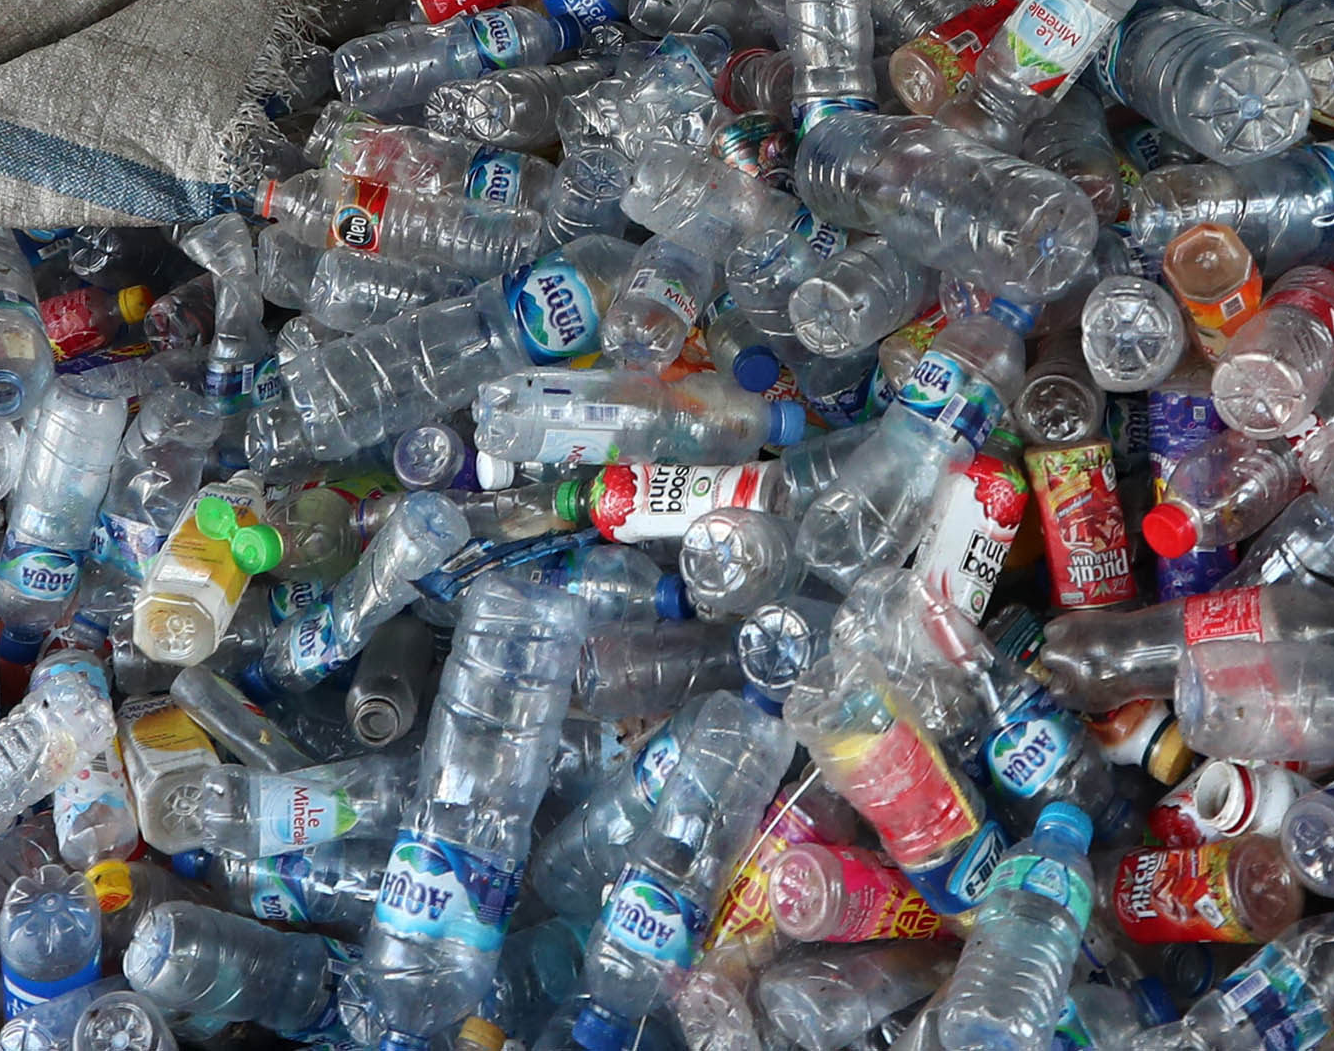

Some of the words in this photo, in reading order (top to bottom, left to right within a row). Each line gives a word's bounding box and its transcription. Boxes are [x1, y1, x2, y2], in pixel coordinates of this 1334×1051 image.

[486, 15, 507, 53] AQUA
[1027, 0, 1083, 49] Minerale
[1035, 26, 1055, 46] Le
[491, 162, 512, 206] AQU
[347, 216, 366, 245] Cleo
[536, 273, 584, 345] AQUA
[914, 361, 952, 395] QUA
[649, 465, 668, 513] nutr
[21, 566, 74, 592] AQUA
[1067, 549, 1130, 585] pucuk
[1004, 729, 1054, 786] AQUA
[307, 807, 324, 828] Le
[966, 835, 1005, 903] prim-a
[381, 870, 453, 921] AQUA
[616, 900, 675, 947] AQUA
